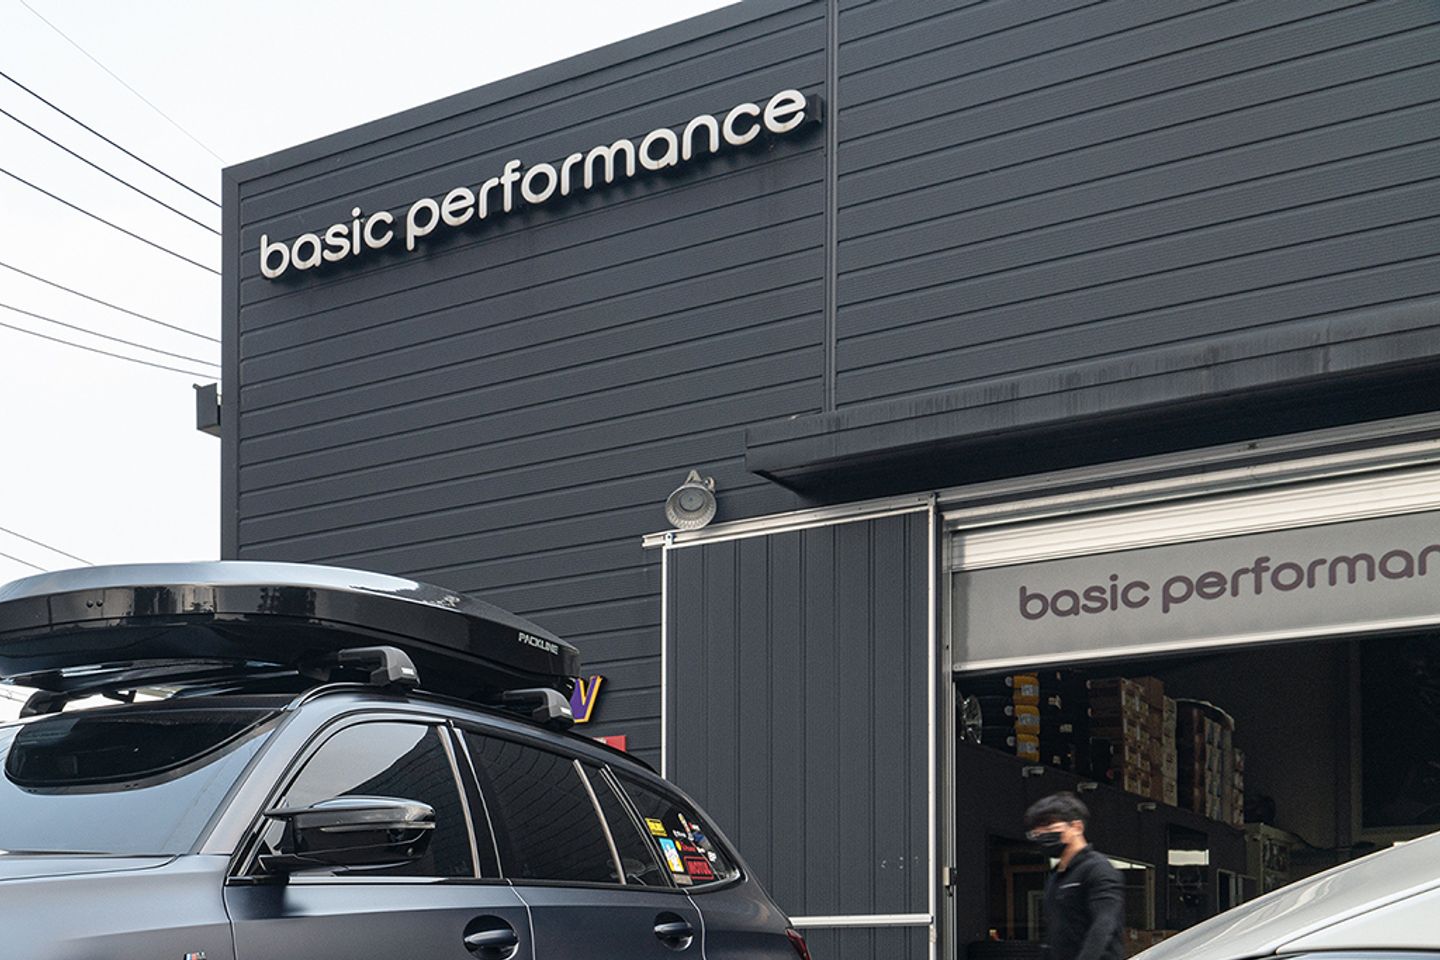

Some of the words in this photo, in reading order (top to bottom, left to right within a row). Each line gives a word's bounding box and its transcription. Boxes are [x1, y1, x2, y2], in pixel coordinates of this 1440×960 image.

[259, 206, 394, 279] basic
[405, 88, 807, 251] performance
[1019, 573, 1151, 621] basic
[518, 631, 559, 655] PACKLINE
